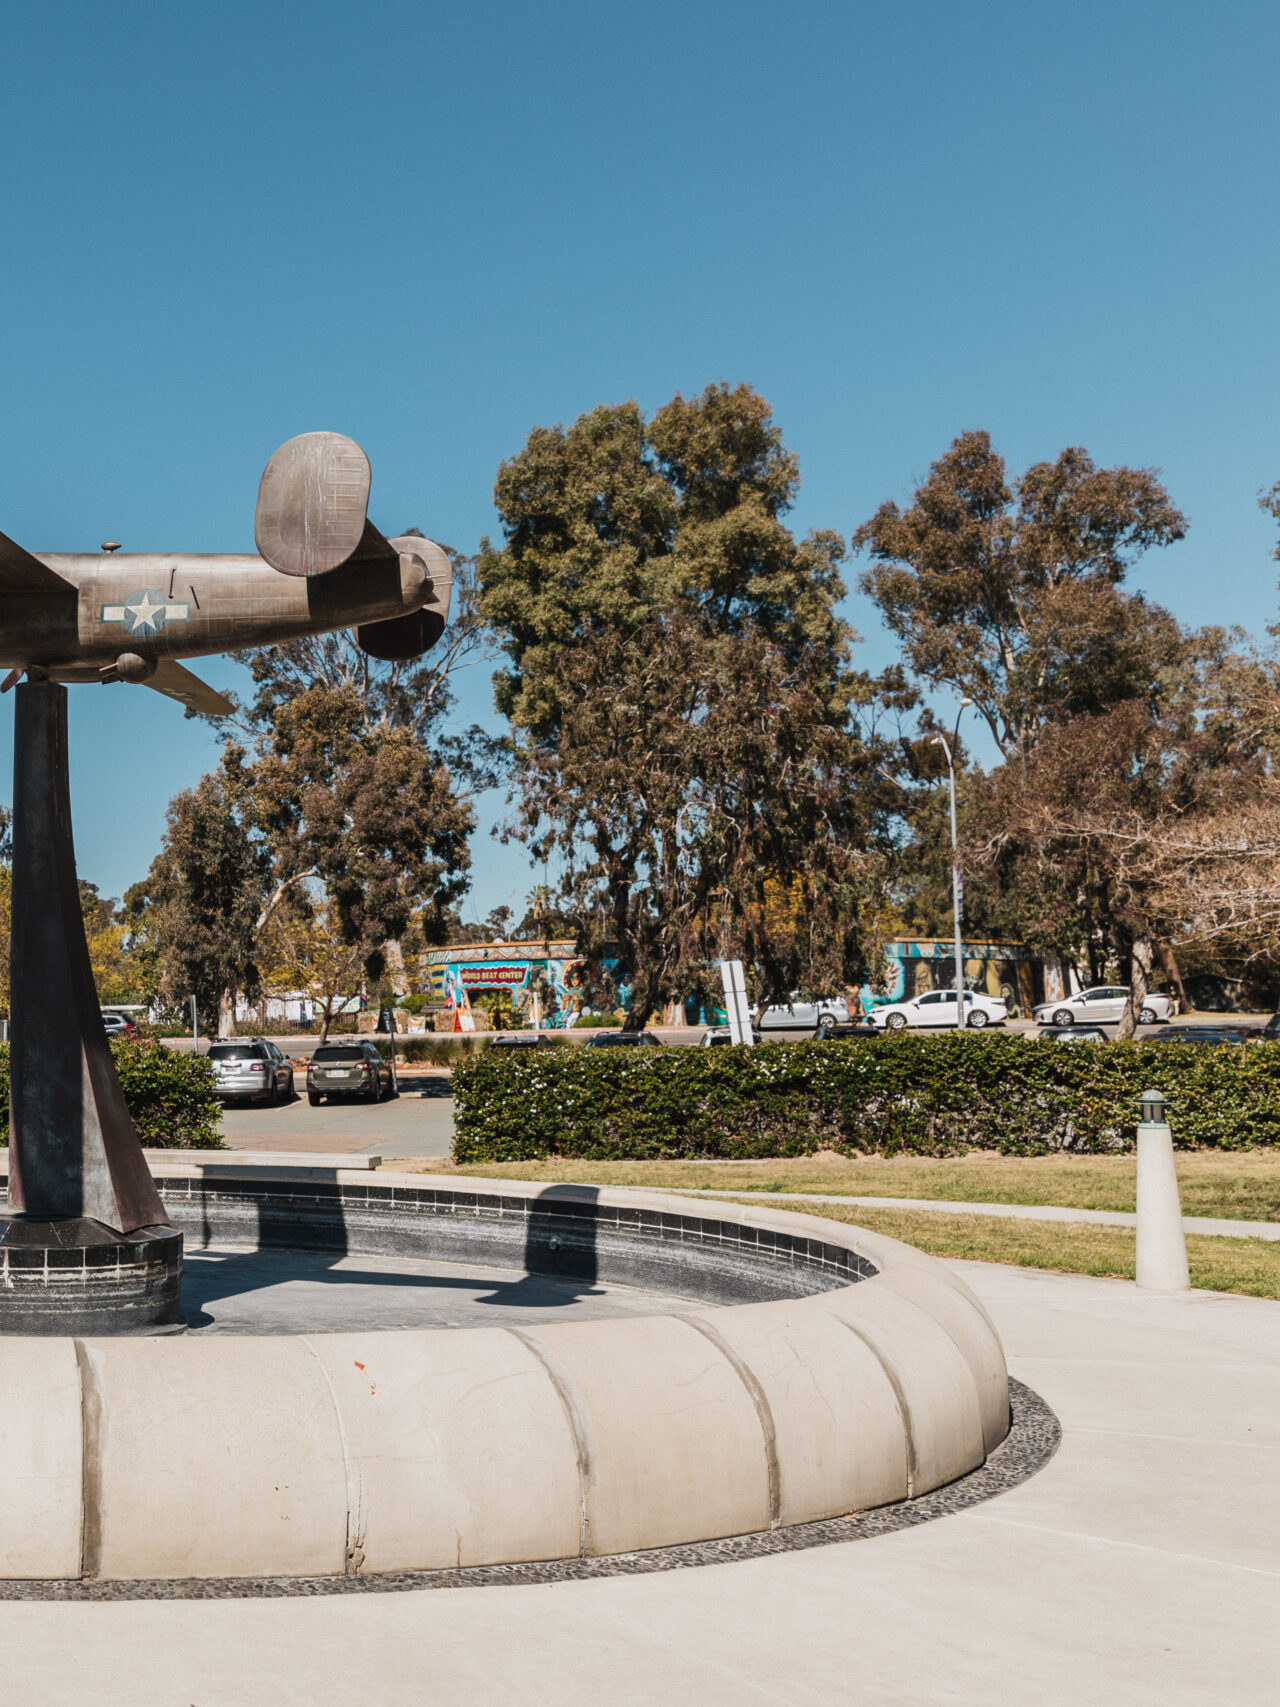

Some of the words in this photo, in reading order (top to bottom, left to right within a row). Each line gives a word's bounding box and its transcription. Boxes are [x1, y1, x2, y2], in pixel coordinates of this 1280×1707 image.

[462, 971, 481, 980] WORLD
[481, 971, 497, 980] BEAT
[498, 971, 523, 979] CENTER
